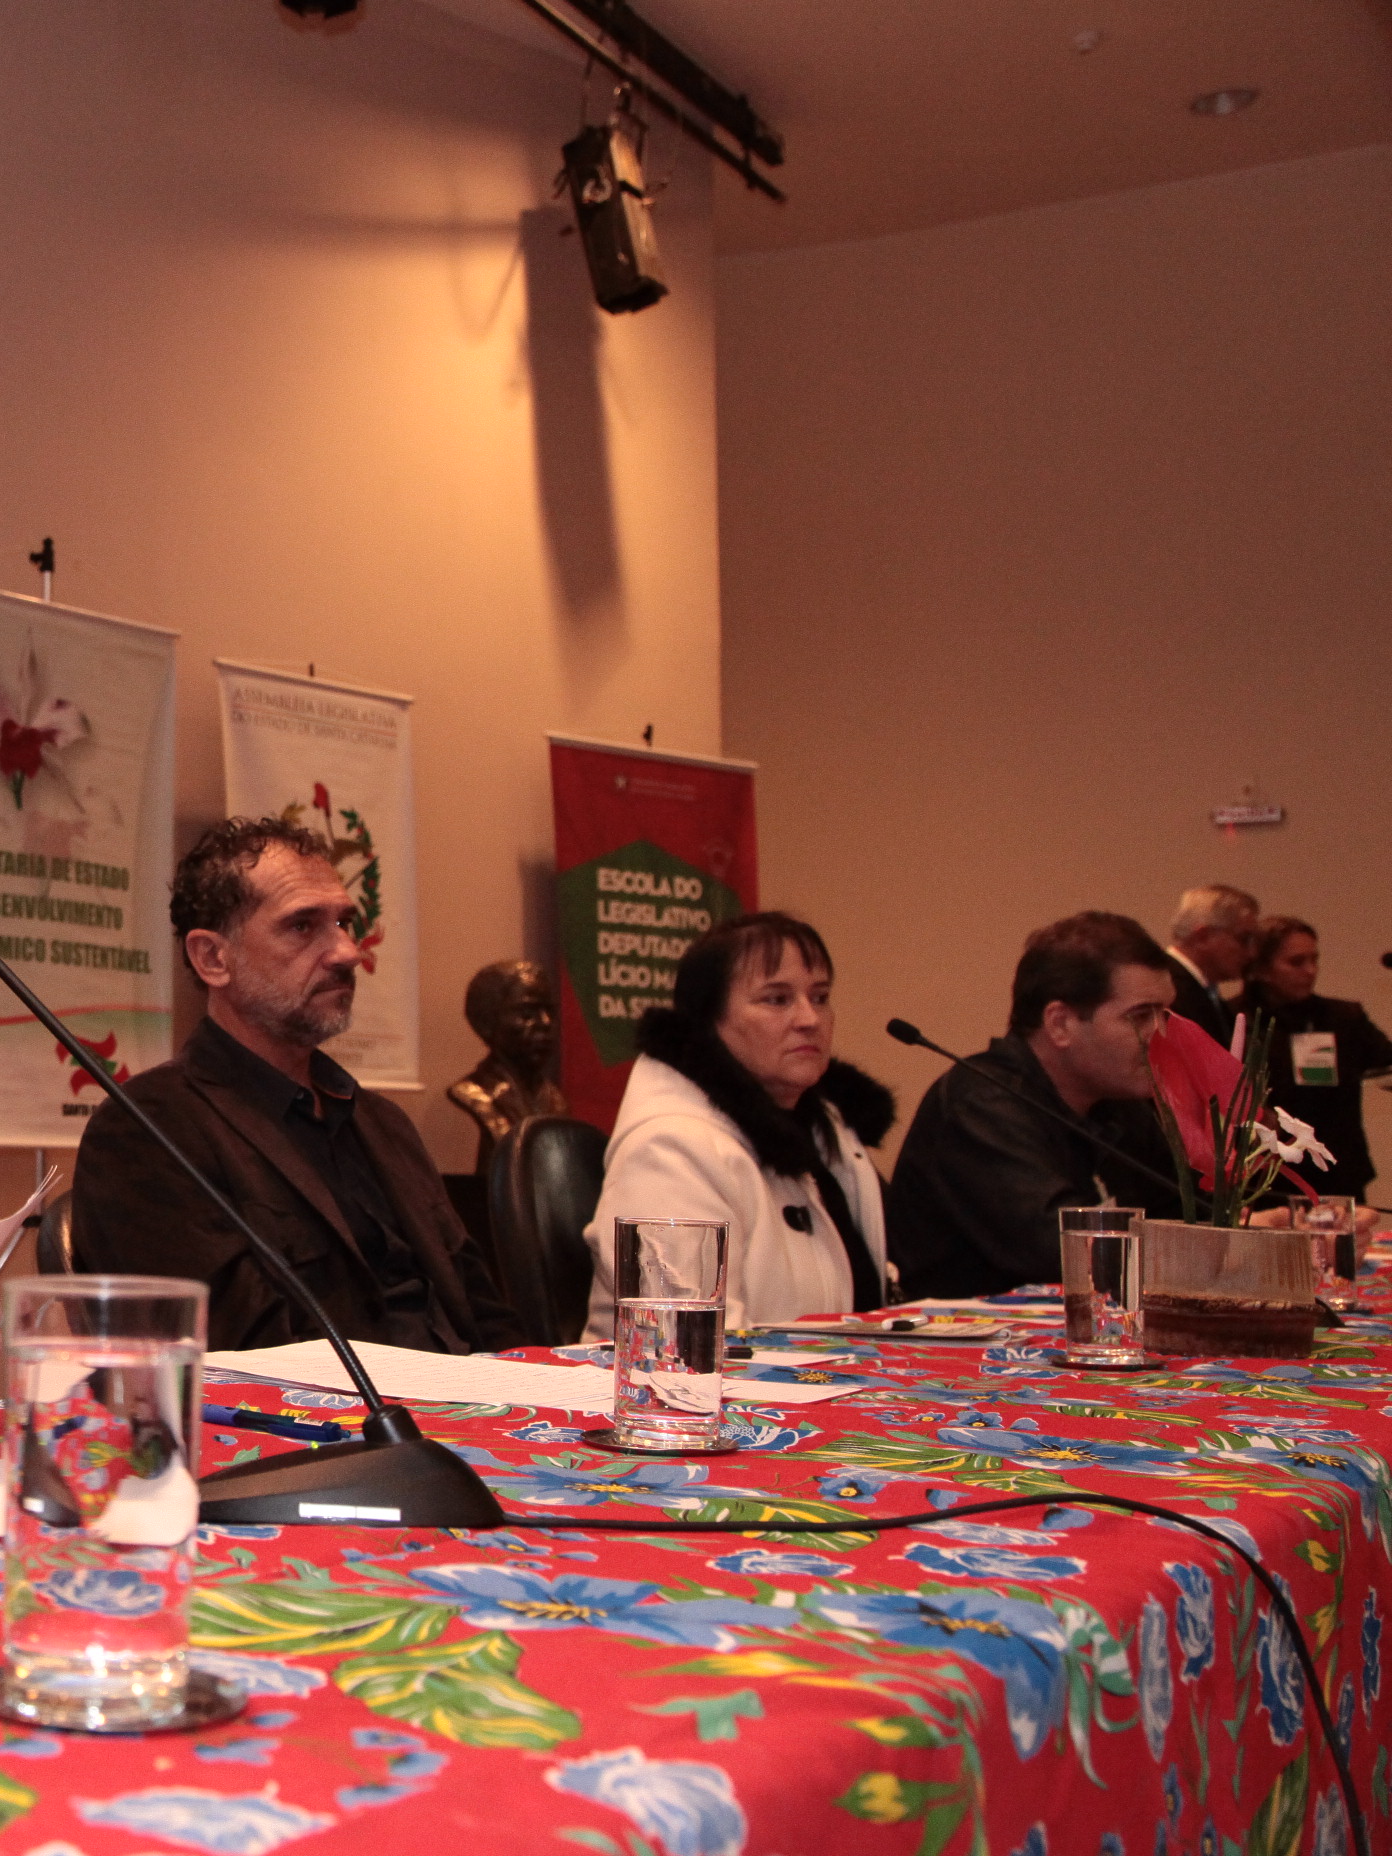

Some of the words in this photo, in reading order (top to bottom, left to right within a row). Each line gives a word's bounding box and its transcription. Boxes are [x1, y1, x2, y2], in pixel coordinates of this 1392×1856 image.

[50, 857, 71, 882] DE
[74, 860, 130, 891] ESTADO
[597, 867, 672, 897] ESCOLA
[673, 876, 704, 900] DO
[597, 900, 712, 932] LEGISLATIVO
[50, 938, 152, 974] SUSTENTÁVEL
[598, 957, 652, 988] LÍCIO
[599, 995, 627, 1019] DA
